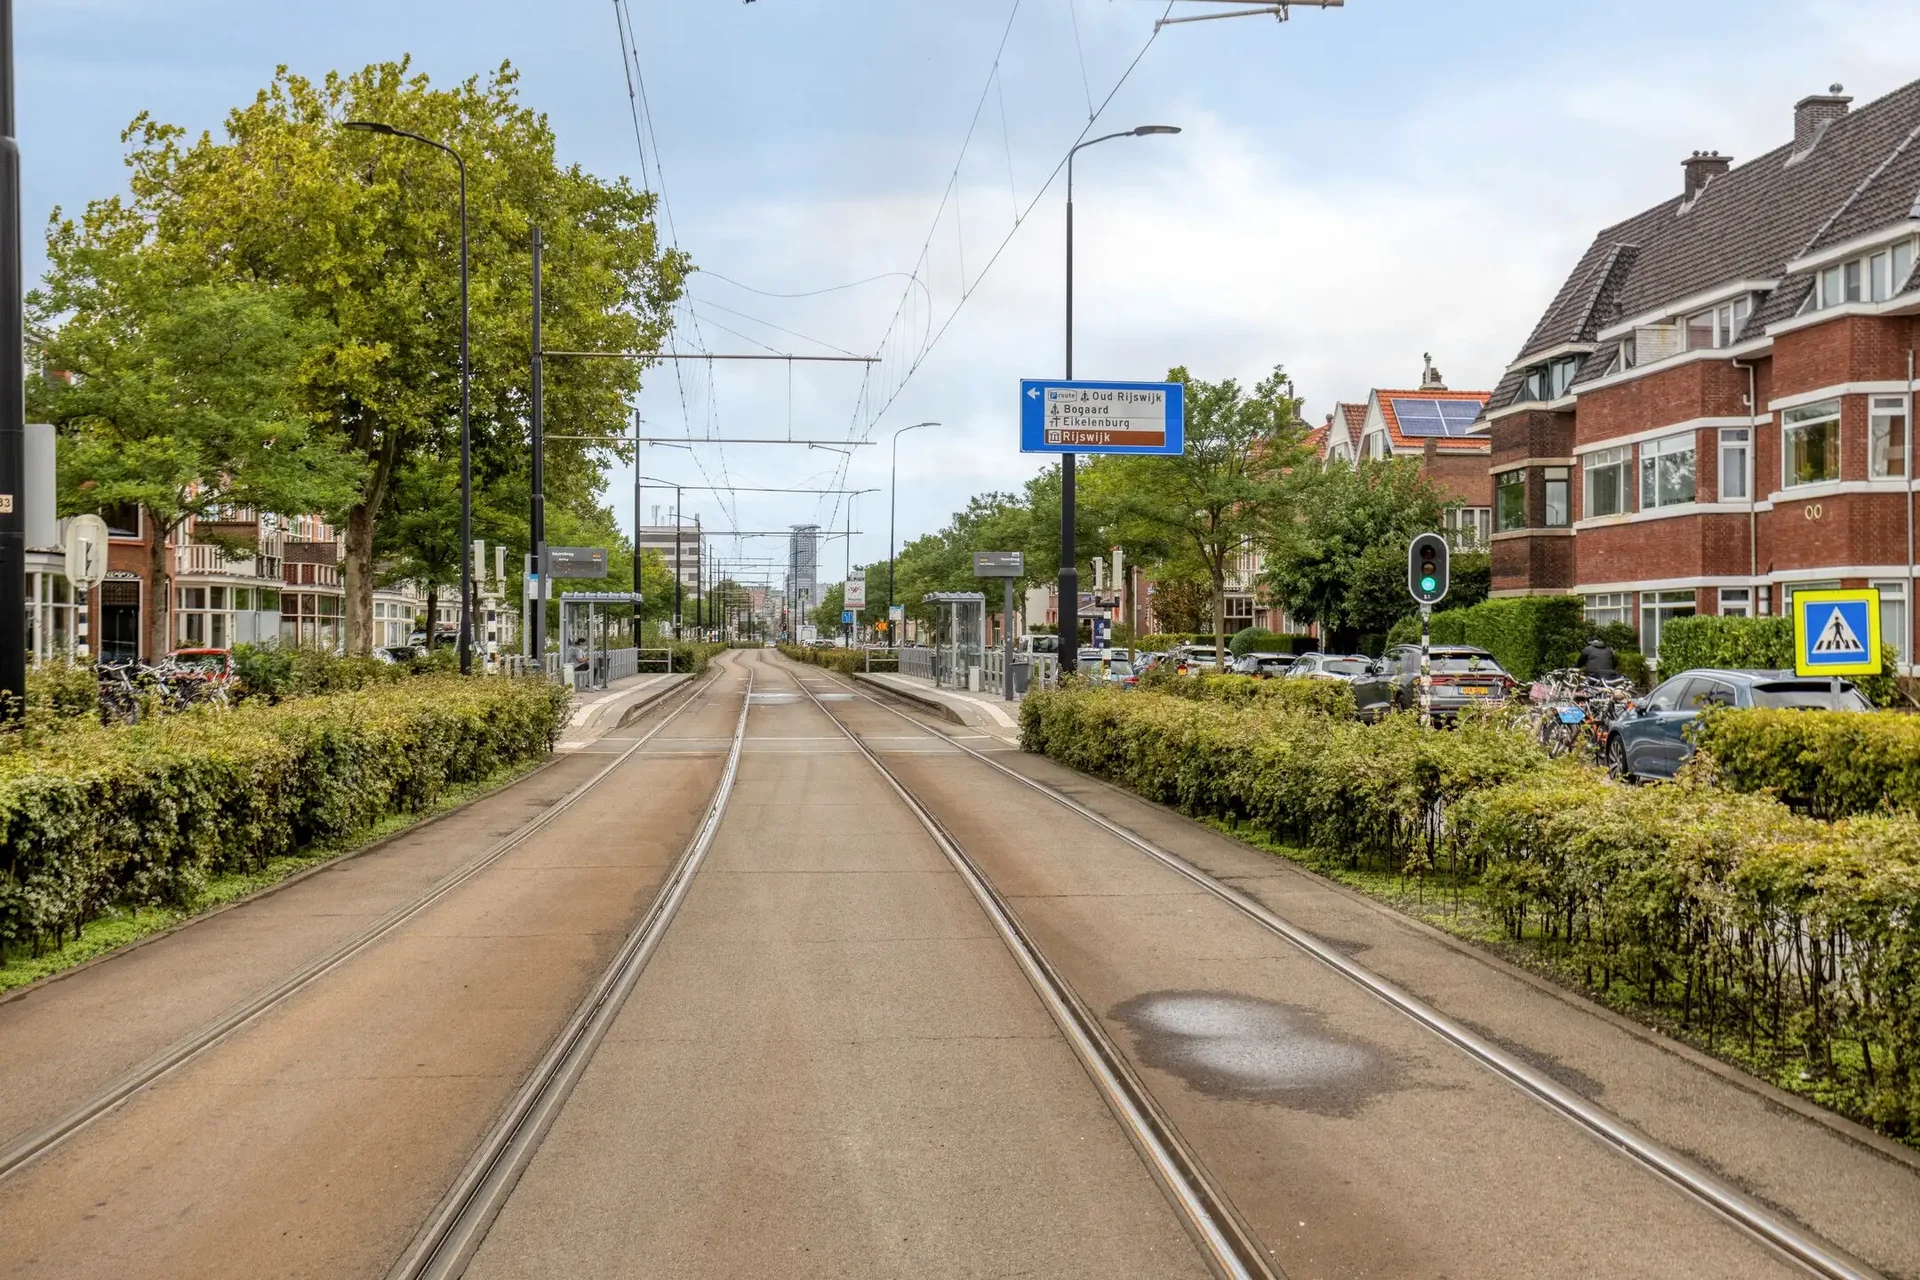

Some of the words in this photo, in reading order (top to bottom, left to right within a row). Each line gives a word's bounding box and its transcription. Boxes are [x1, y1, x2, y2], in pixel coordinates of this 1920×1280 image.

[1092, 391, 1113, 401] Oud
[1117, 392, 1162, 404] Rijswijk
[1064, 404, 1109, 416] Bogaard
[1063, 417, 1130, 429] Eikelenburg
[1063, 431, 1110, 444] Rijswijk
